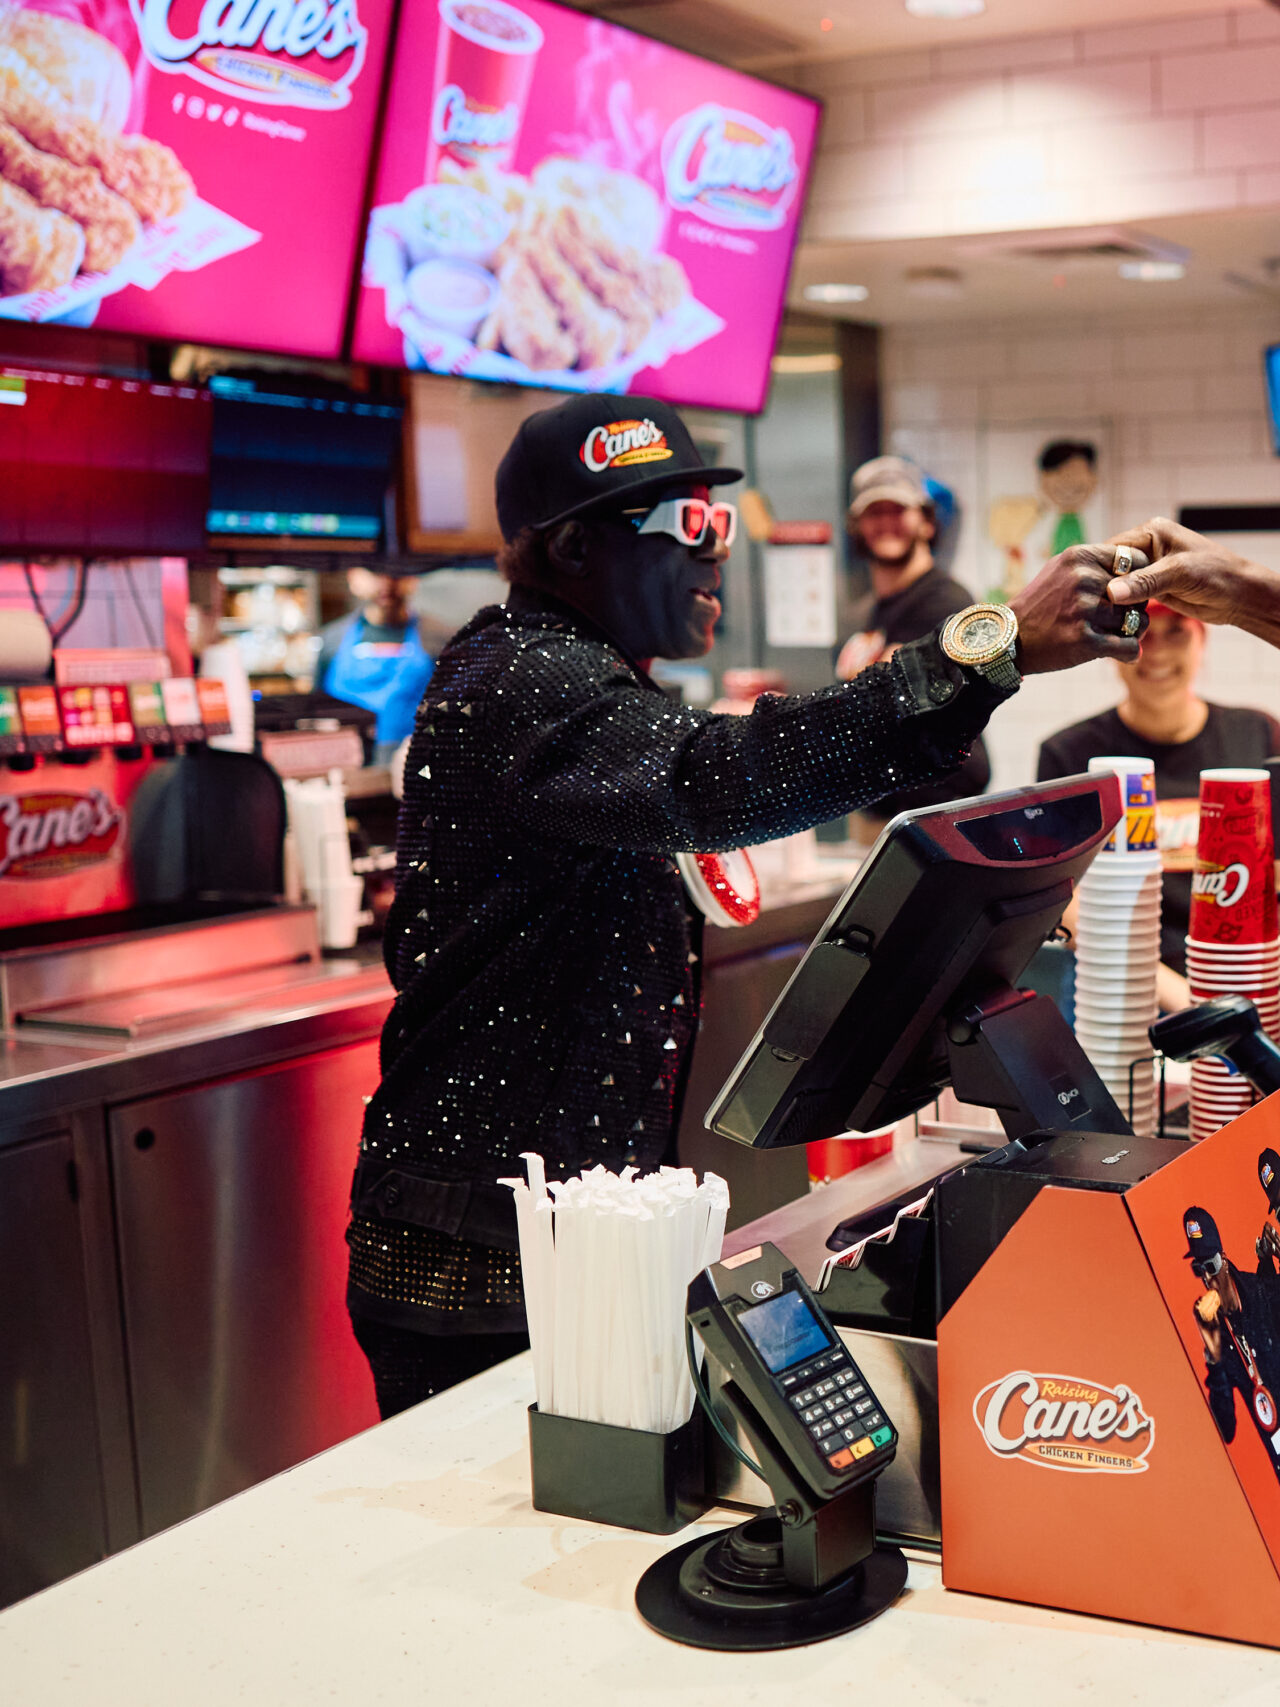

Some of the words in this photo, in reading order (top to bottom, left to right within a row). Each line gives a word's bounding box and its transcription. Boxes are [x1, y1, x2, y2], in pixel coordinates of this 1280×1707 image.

[583, 418, 664, 472] Cane's
[983, 1372, 1150, 1451] Cane's
[1041, 1381, 1099, 1404] Raising
[1038, 1444, 1084, 1462] CHICKEN
[1087, 1452, 1134, 1468] FINGERS
